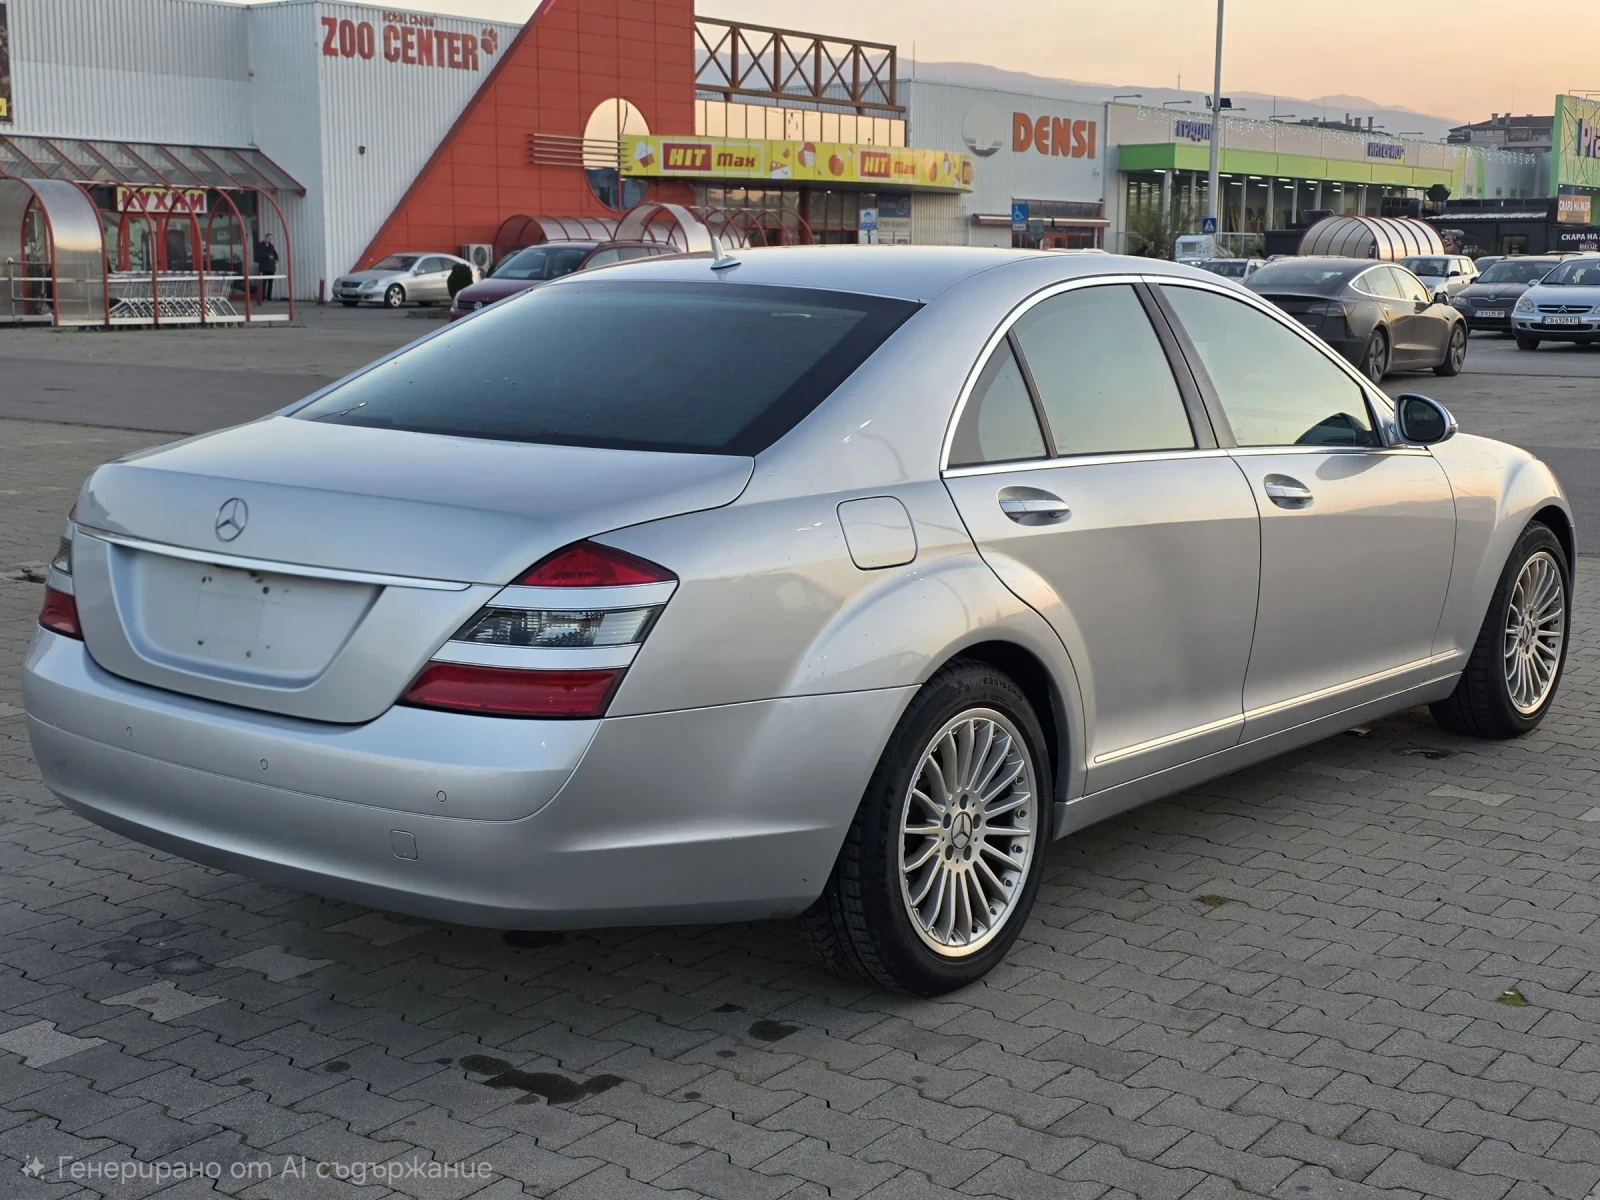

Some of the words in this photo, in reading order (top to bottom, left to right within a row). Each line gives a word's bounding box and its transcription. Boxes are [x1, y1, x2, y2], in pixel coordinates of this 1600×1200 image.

[321, 16, 375, 60] ZOO
[383, 24, 479, 72] CENTER
[1012, 111, 1097, 160] DENSI
[668, 147, 707, 167] HIT
[716, 152, 756, 168] Max
[863, 156, 888, 174] HIT
[893, 161, 916, 175] Max
[121, 190, 205, 211] КУХНИ
[1561, 233, 1586, 241] СКАРА
